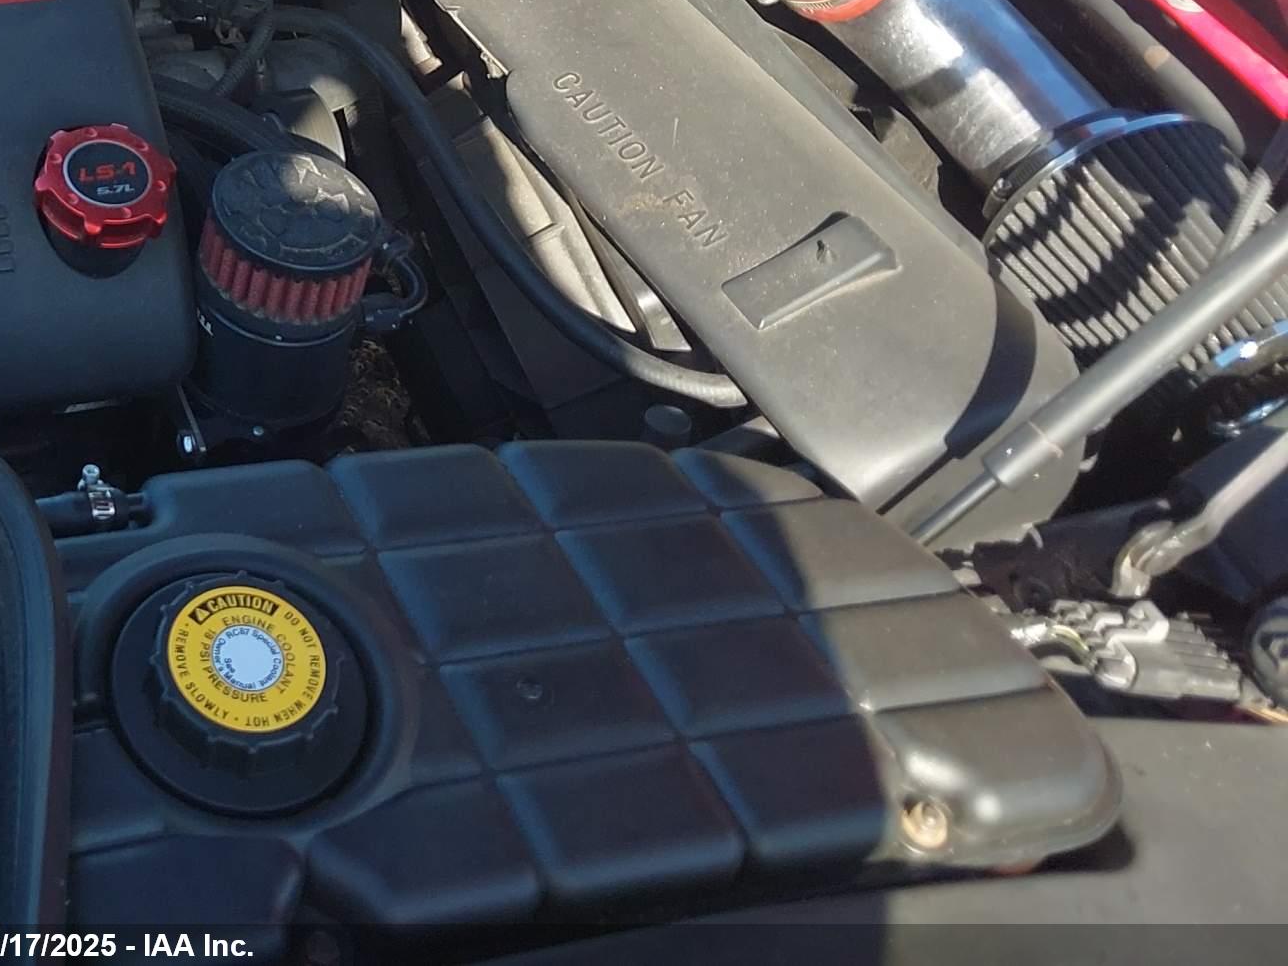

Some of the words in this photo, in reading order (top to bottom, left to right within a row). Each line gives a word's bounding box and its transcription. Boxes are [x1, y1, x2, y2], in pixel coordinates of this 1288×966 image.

[553, 72, 664, 180] CAUTION
[662, 189, 728, 248] FAN
[96, 183, 134, 195] 5.7L
[207, 594, 273, 614] CAUTION
[284, 611, 300, 626] DO
[299, 627, 317, 648] NOT
[199, 642, 211, 662] PSI
[222, 615, 276, 632] ENGINE
[276, 634, 295, 694] COOLANT
[175, 629, 190, 677] REMOVE
[185, 682, 230, 720] SLOWLY
[202, 666, 269, 703] PRESSURE
[302, 654, 320, 700] REMOVE
[275, 699, 306, 720] WHEN
[245, 717, 270, 727] HOT
